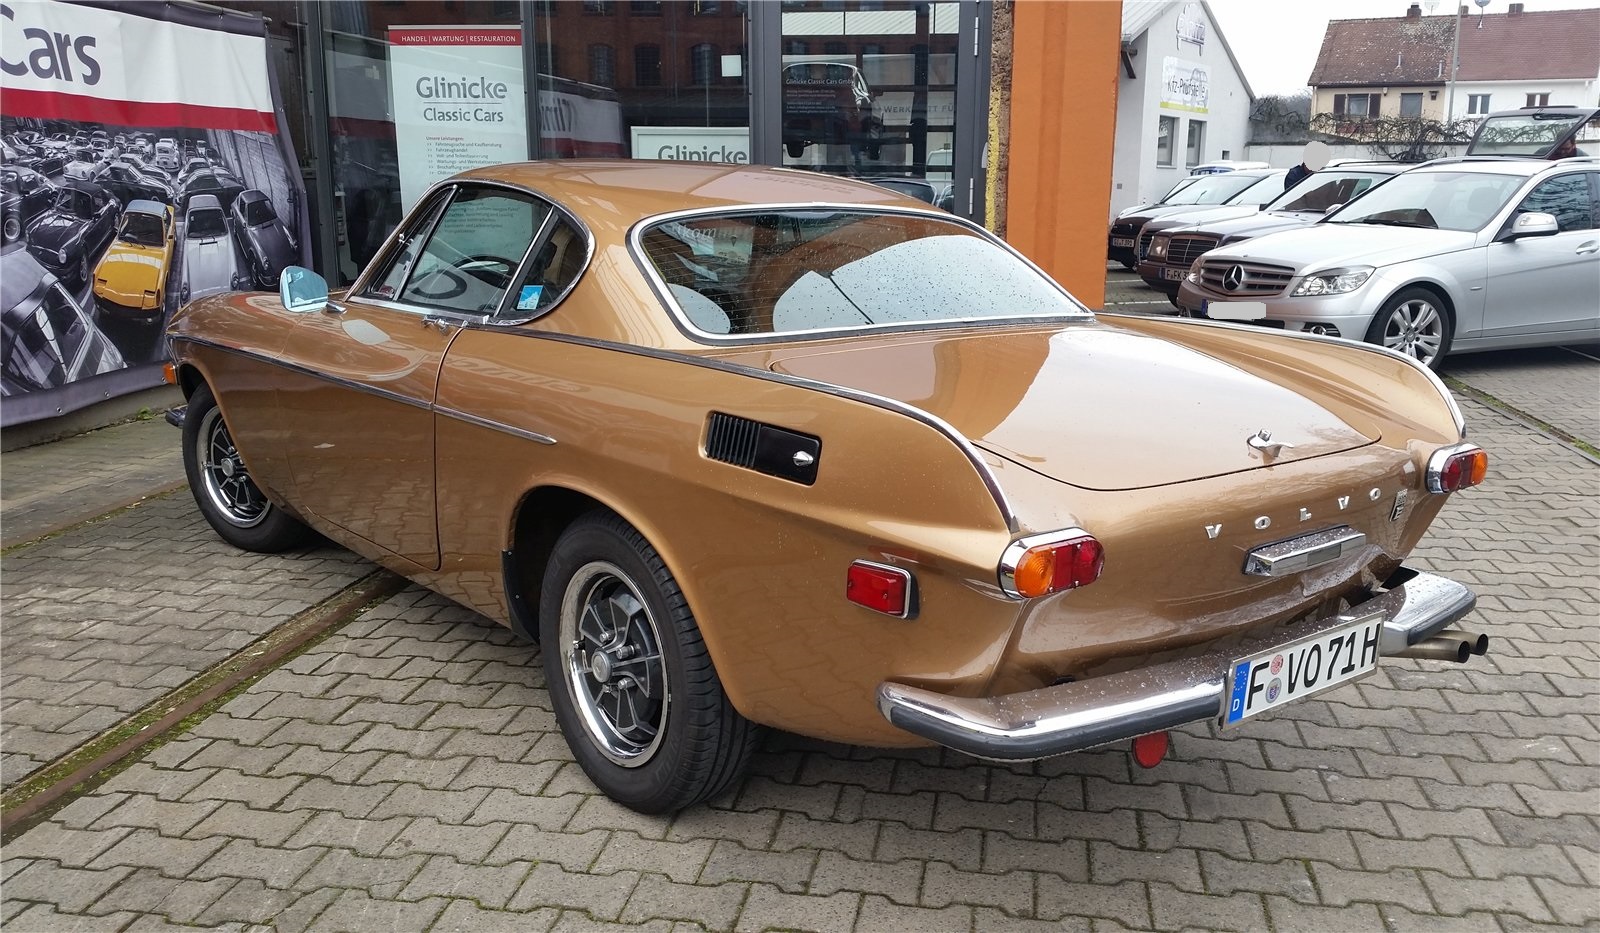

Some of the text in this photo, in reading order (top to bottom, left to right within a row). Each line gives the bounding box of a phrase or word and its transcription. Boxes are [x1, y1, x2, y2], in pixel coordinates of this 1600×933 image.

[0, 3, 101, 86] Cars
[416, 76, 507, 99] Glinicke
[423, 107, 504, 122] Classic Cars
[657, 144, 748, 164] Glinicke
[1205, 488, 1381, 538] VOLVO
[1232, 698, 1240, 712] D
[1246, 661, 1270, 710] F
